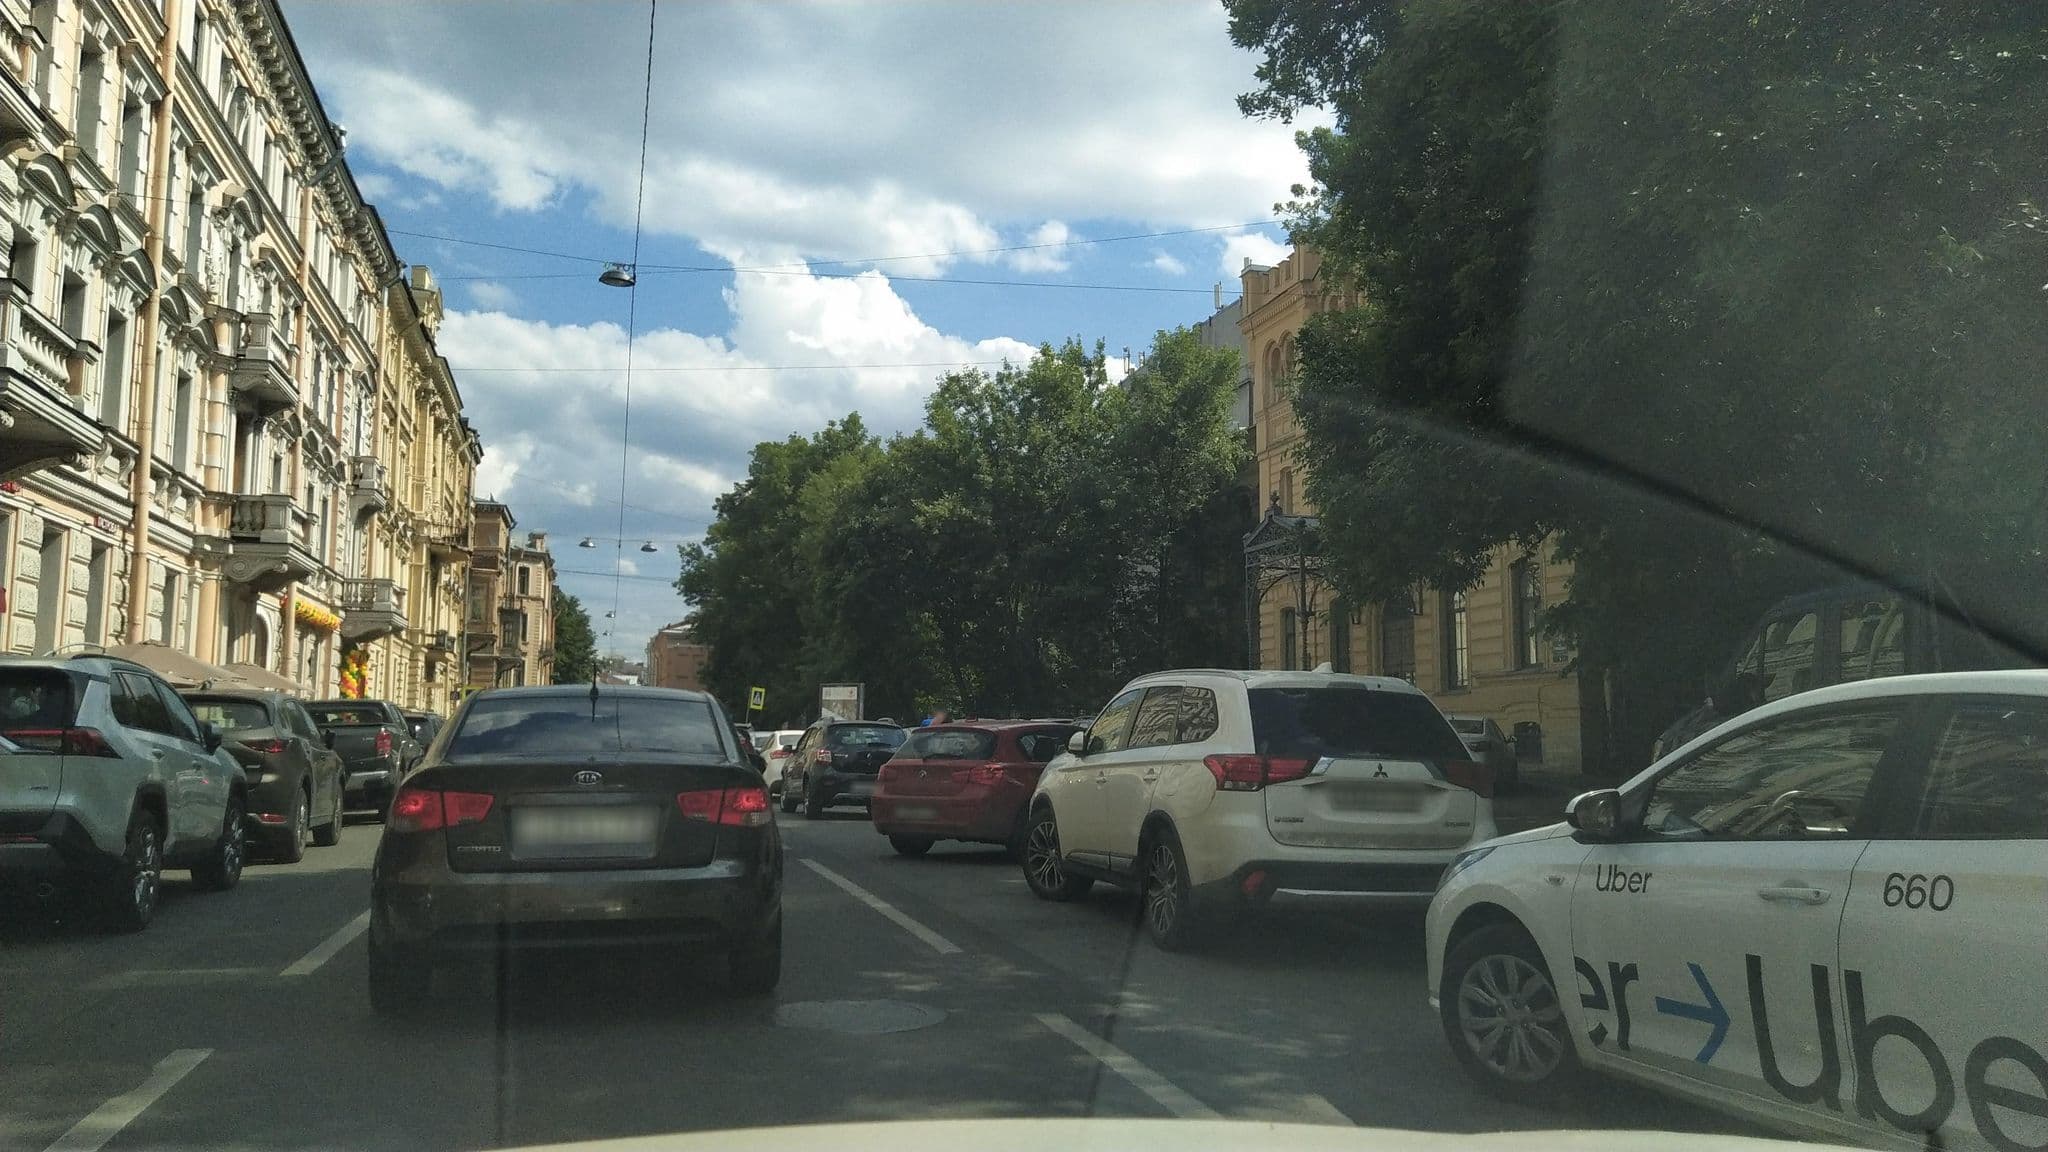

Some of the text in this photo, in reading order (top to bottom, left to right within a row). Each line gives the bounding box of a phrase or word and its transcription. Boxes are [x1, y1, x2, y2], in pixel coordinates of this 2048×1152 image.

[577, 772, 599, 784] KIA
[1596, 863, 1653, 893] Uber
[1883, 872, 1954, 912] 660
